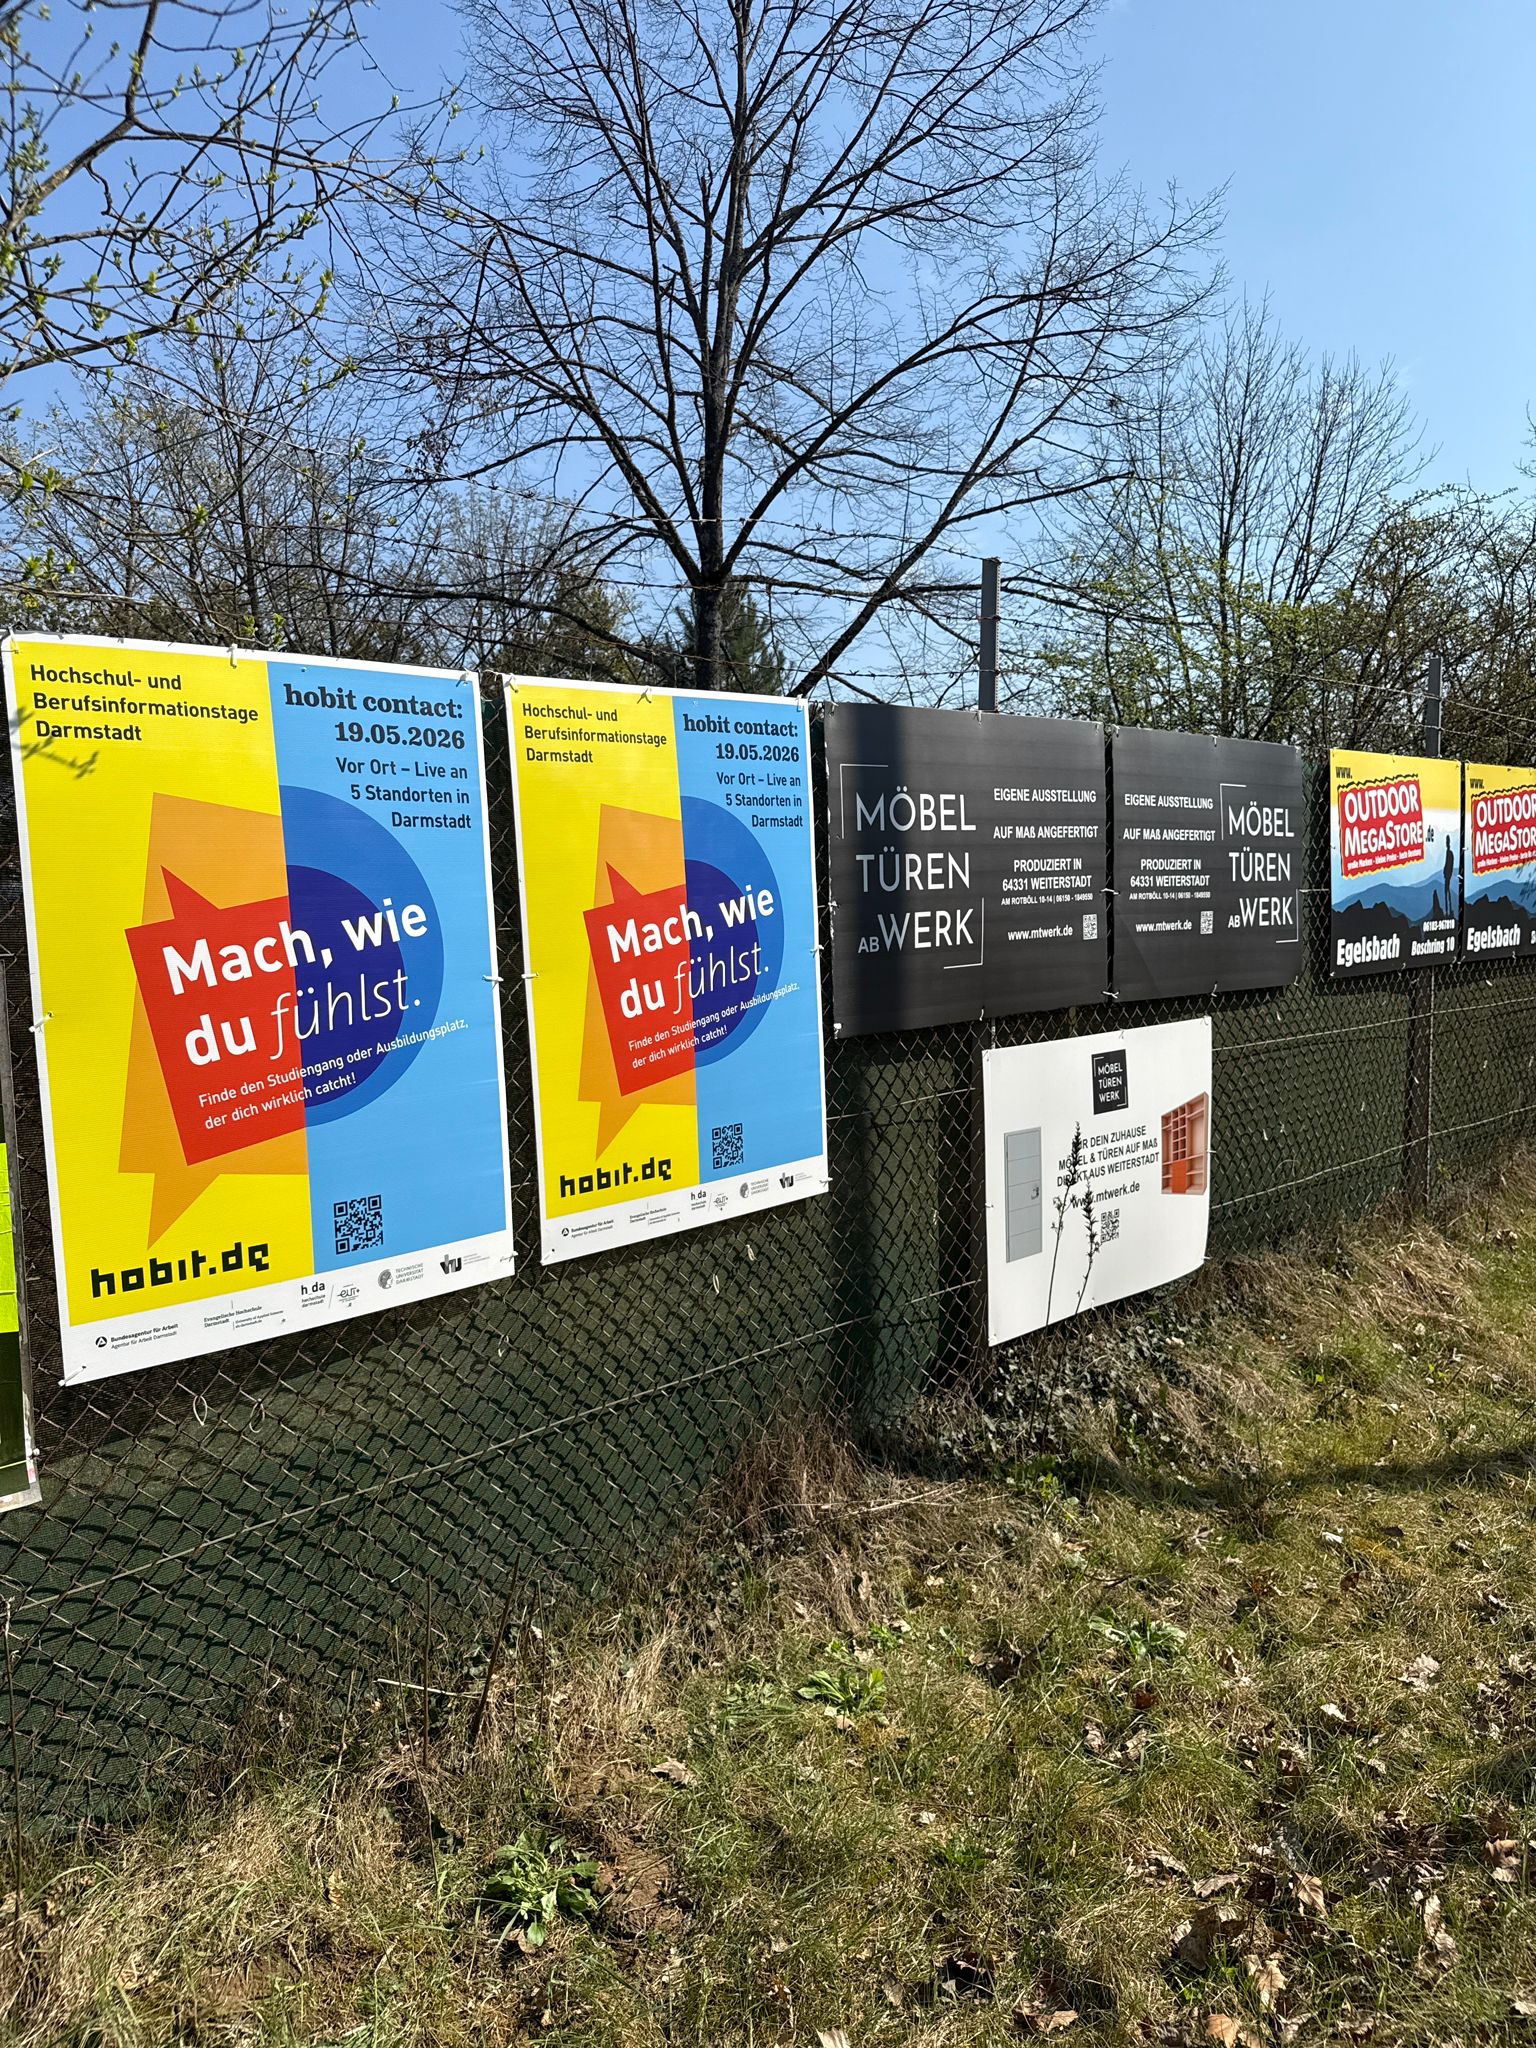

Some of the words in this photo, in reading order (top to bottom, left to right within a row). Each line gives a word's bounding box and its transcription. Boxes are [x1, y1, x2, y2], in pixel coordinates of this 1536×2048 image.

[31, 664, 141, 687] Hochschul-
[148, 675, 181, 690] und
[34, 692, 258, 723] Berufsinformationstage
[283, 684, 357, 710] hobit
[363, 696, 462, 718] contact:
[523, 703, 592, 720] Hochschul-
[596, 708, 618, 722] und
[36, 720, 142, 740] Darmstadt
[335, 722, 465, 749] 19.05.2026
[683, 714, 730, 734] hobit
[734, 721, 798, 737] contact:
[525, 726, 667, 747] Berufsinformationstage
[527, 748, 593, 763] Darmstadt
[716, 743, 799, 762] 19.05.2026
[336, 757, 365, 773] Vor
[370, 759, 396, 775] Ort
[415, 762, 446, 777] Live
[451, 768, 467, 779] an
[717, 772, 735, 785] Vor
[738, 773, 755, 786] Ort
[767, 773, 787, 786] Live
[790, 777, 801, 787] an
[352, 785, 360, 799] 5
[366, 785, 452, 803] Standorten
[457, 789, 469, 803] in
[726, 794, 732, 806] 5
[735, 794, 791, 807] Standorten
[793, 797, 802, 807] in
[994, 788, 1029, 801] EIGENE
[1032, 790, 1097, 803] AUSSTELLUNG
[1125, 794, 1156, 806] EIGENE
[1158, 796, 1213, 809] AUSSTELLUNG
[1345, 784, 1419, 823] OUTDOOR
[856, 786, 976, 831] MÖBEL
[392, 812, 471, 828] Darmstadt
[752, 815, 803, 828] Darmstadt
[1229, 801, 1294, 837] MÖBEL
[993, 826, 1013, 838] AUF
[1037, 825, 1098, 838] ANGEFERTIGT
[1123, 828, 1141, 839] AUF
[1163, 830, 1215, 841] ANGEFERTIGT
[856, 846, 969, 892] TÜREN
[1014, 858, 1071, 872] PRODUZIERT
[1074, 858, 1082, 870] IN
[1141, 859, 1192, 870] PRODUZIERT
[1194, 860, 1201, 870] IN
[1229, 847, 1290, 882] TÜREN
[1003, 878, 1028, 891] 64331
[1031, 875, 1091, 890] WEITERSTADT
[1131, 876, 1154, 888] 64331
[1156, 875, 1210, 886] WEITERSTADT
[1012, 895, 1038, 905] ROTBÖLL
[606, 904, 713, 963] Mach,
[719, 885, 774, 928] wie
[1008, 925, 1073, 941] www.mtwerk.de
[1136, 920, 1192, 932] www.mtwerk.de
[162, 921, 332, 996] Mach,
[341, 897, 428, 952] wie
[1411, 939, 1444, 956] Boschring
[1446, 936, 1455, 951] 10
[1467, 924, 1520, 951] Egelsbach
[1337, 934, 1399, 967] Egelsbach
[620, 978, 665, 1019] du
[673, 942, 769, 1015] fühlst.
[185, 1013, 258, 1066] du
[269, 968, 421, 1060] fühlst.
[629, 1035, 652, 1051] Finde
[654, 1029, 670, 1042] den
[671, 1012, 719, 1036] Studiengang
[721, 1005, 738, 1018] oder
[740, 982, 800, 1011] Ausbildungsplatz,
[632, 1056, 646, 1068] der
[649, 1049, 666, 1063] dich
[668, 1035, 700, 1056] wirklich
[701, 1025, 727, 1043] catcht!
[199, 1089, 237, 1108] Finde
[241, 1079, 265, 1096] den
[267, 1057, 344, 1088] Studiengang
[346, 1046, 372, 1064] oder
[376, 1018, 468, 1055] Ausbildungsplatz,
[1098, 1062, 1123, 1075] MÖBEL
[1099, 1076, 1122, 1088] TÜREN
[204, 1114, 227, 1129] der
[232, 1104, 259, 1122] dich
[261, 1088, 313, 1116] wirklich
[315, 1072, 357, 1096] catcht!
[1099, 1092, 1119, 1102] WERK
[1090, 1133, 1109, 1147] DEIN
[1110, 1125, 1146, 1142] ZUHAUSE
[1059, 1155, 1088, 1170] MÖEL
[1090, 1153, 1095, 1162] &
[1098, 1146, 1124, 1160] TÜREN
[1125, 1142, 1141, 1154] AUF
[560, 1157, 671, 1197] hobit.de
[1057, 1171, 1087, 1187] DIRKT
[1089, 1166, 1105, 1179] AUS
[1107, 1152, 1159, 1174] WEITERSTADT
[91, 1242, 269, 1298] hobit.de
[396, 1263, 423, 1273] TECHNISCHE
[396, 1268, 424, 1279] UNIVERSITÄT
[204, 1311, 235, 1322] Evangelische
[236, 1305, 262, 1315] Hochschule
[204, 1318, 230, 1327] Darmstadt
[111, 1329, 152, 1342] Bundesagentur
